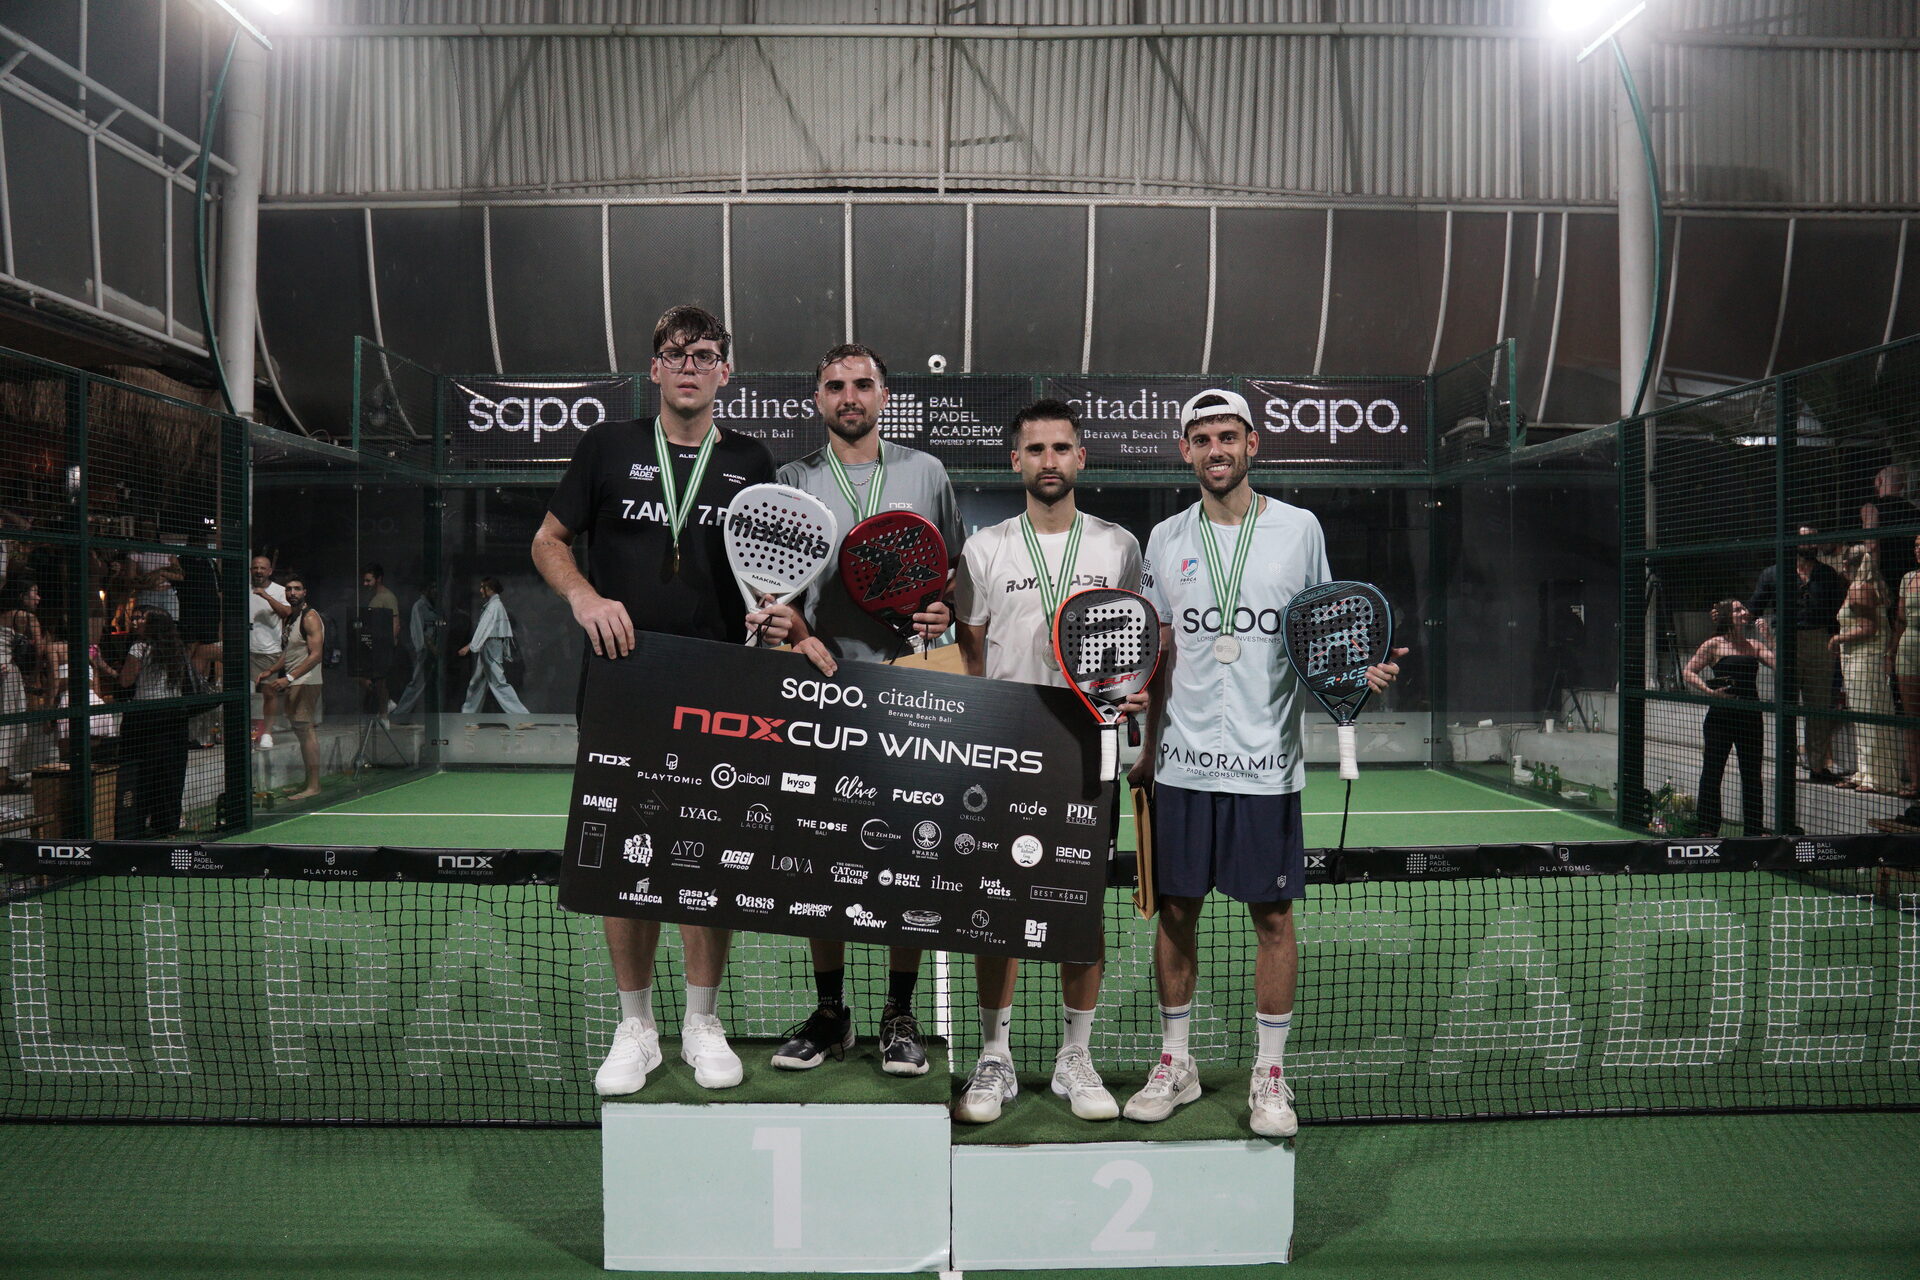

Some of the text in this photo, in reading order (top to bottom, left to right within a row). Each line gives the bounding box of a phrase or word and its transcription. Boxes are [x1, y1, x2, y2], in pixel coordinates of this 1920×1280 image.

[712, 387, 815, 420] adines
[929, 397, 963, 408] BALI
[1066, 389, 1180, 420] citadin
[467, 396, 606, 442] sapo
[929, 411, 980, 422] PADEL
[1264, 398, 1408, 444] sapo.
[772, 429, 794, 439] Bali
[929, 426, 1004, 436] ACADEMY
[1084, 430, 1128, 439] Berawa
[1132, 430, 1168, 439] Beach
[1120, 444, 1158, 454] Resort
[629, 470, 655, 478] PADEL
[632, 464, 660, 473] ISLAND
[728, 514, 830, 560] makina
[751, 574, 782, 587] MAKINA
[1006, 574, 1109, 593] ROYL ADEL
[781, 678, 867, 710] sapo.
[878, 688, 965, 714] citadines
[888, 710, 914, 720] Berawa
[916, 713, 936, 722] Beach
[908, 721, 930, 729] Resort
[878, 732, 1043, 774] WINNERS
[1161, 743, 1288, 770] PANORAMIC
[637, 771, 702, 786] PLAYTOMIC
[1186, 768, 1259, 779] PADEL CONSULTING
[834, 775, 878, 799] Alive
[583, 794, 618, 813] DANG!
[832, 797, 876, 806] WHOLEFOODS
[892, 788, 944, 806] FUEGO
[1009, 801, 1047, 817] nüde
[1066, 803, 1098, 820] PDL
[746, 810, 772, 824] EOS
[959, 814, 986, 822] ORIGEN
[741, 822, 775, 831] LACREE
[797, 818, 848, 832] THE DOSE
[721, 850, 754, 865] OGGI
[1056, 846, 1091, 860] BEND
[830, 866, 869, 879] CATong
[895, 873, 920, 881] SUKI
[834, 874, 864, 885] Laksa
[930, 875, 963, 892] ilme
[980, 876, 1000, 889] just
[619, 892, 662, 904] LA BARACCA
[679, 889, 703, 898] casa
[987, 887, 1011, 897] oats
[1034, 890, 1084, 900] BEST KEBAB
[679, 896, 707, 906] tierra
[735, 894, 775, 910] Oasis
[802, 903, 832, 912] HUNGRY
[859, 911, 873, 919] GO
[854, 918, 887, 928] NANNY
[752, 1126, 802, 1250] 1
[1090, 1158, 1158, 1252] 2
